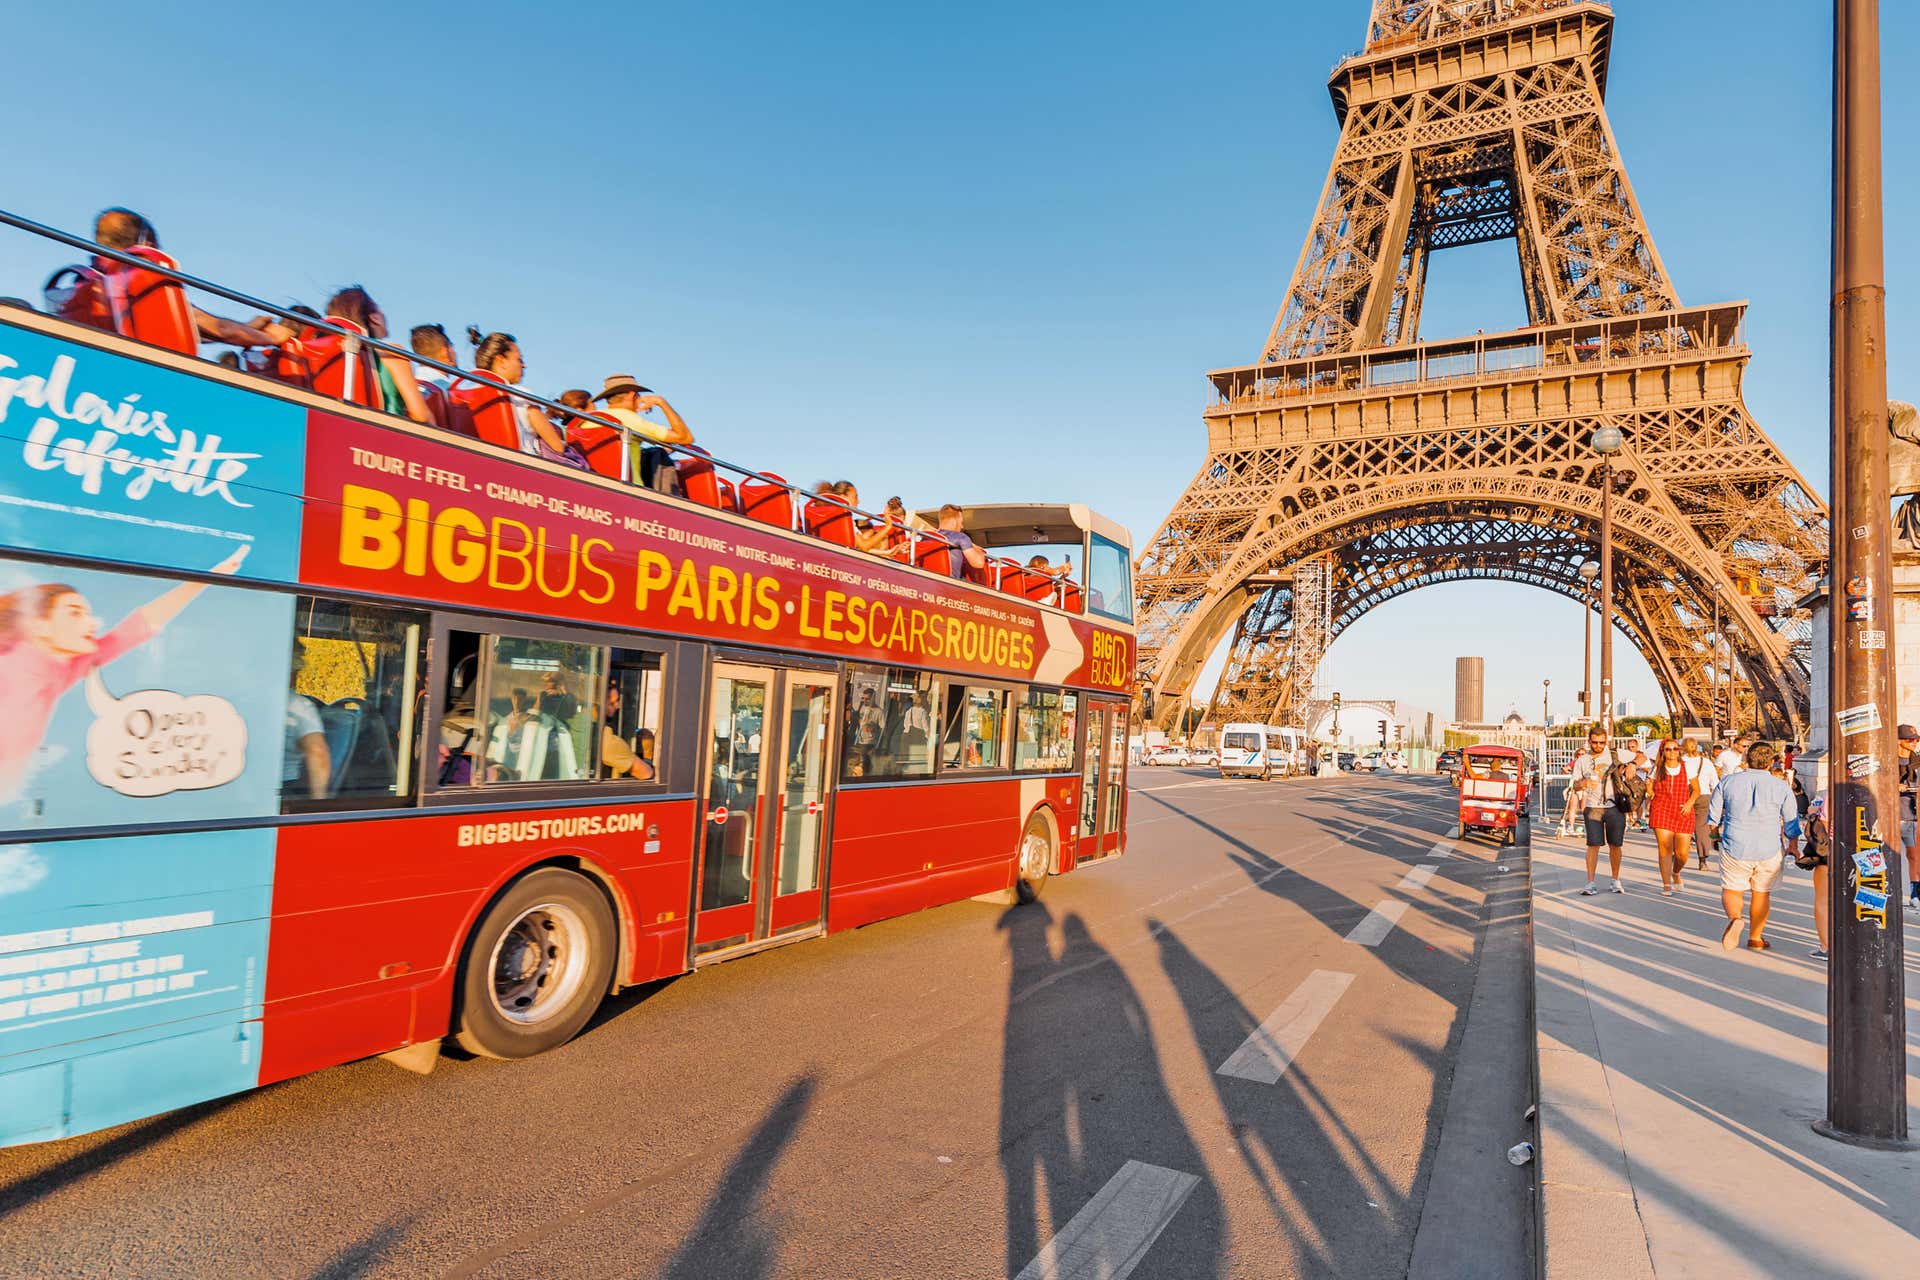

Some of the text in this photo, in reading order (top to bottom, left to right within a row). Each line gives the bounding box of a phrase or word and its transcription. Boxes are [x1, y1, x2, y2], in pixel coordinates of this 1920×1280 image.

[23, 417, 264, 508] Lafayette
[349, 446, 405, 476] TOUR
[486, 481, 613, 526] CHAMP-DE-MARS
[623, 516, 666, 539] MUSÉE
[667, 529, 685, 543] DU
[686, 531, 728, 554] LOUVRE
[735, 544, 797, 571] NOTRE-DAME
[803, 561, 831, 579] MUSÉE
[831, 568, 862, 586] D'ORSAY
[867, 577, 890, 593] OPÉRA
[890, 583, 919, 600] GARNIER
[1093, 630, 1113, 660] BIG
[1091, 659, 1112, 686] BUS
[456, 812, 645, 848] BIGBUSTOURS.COM
